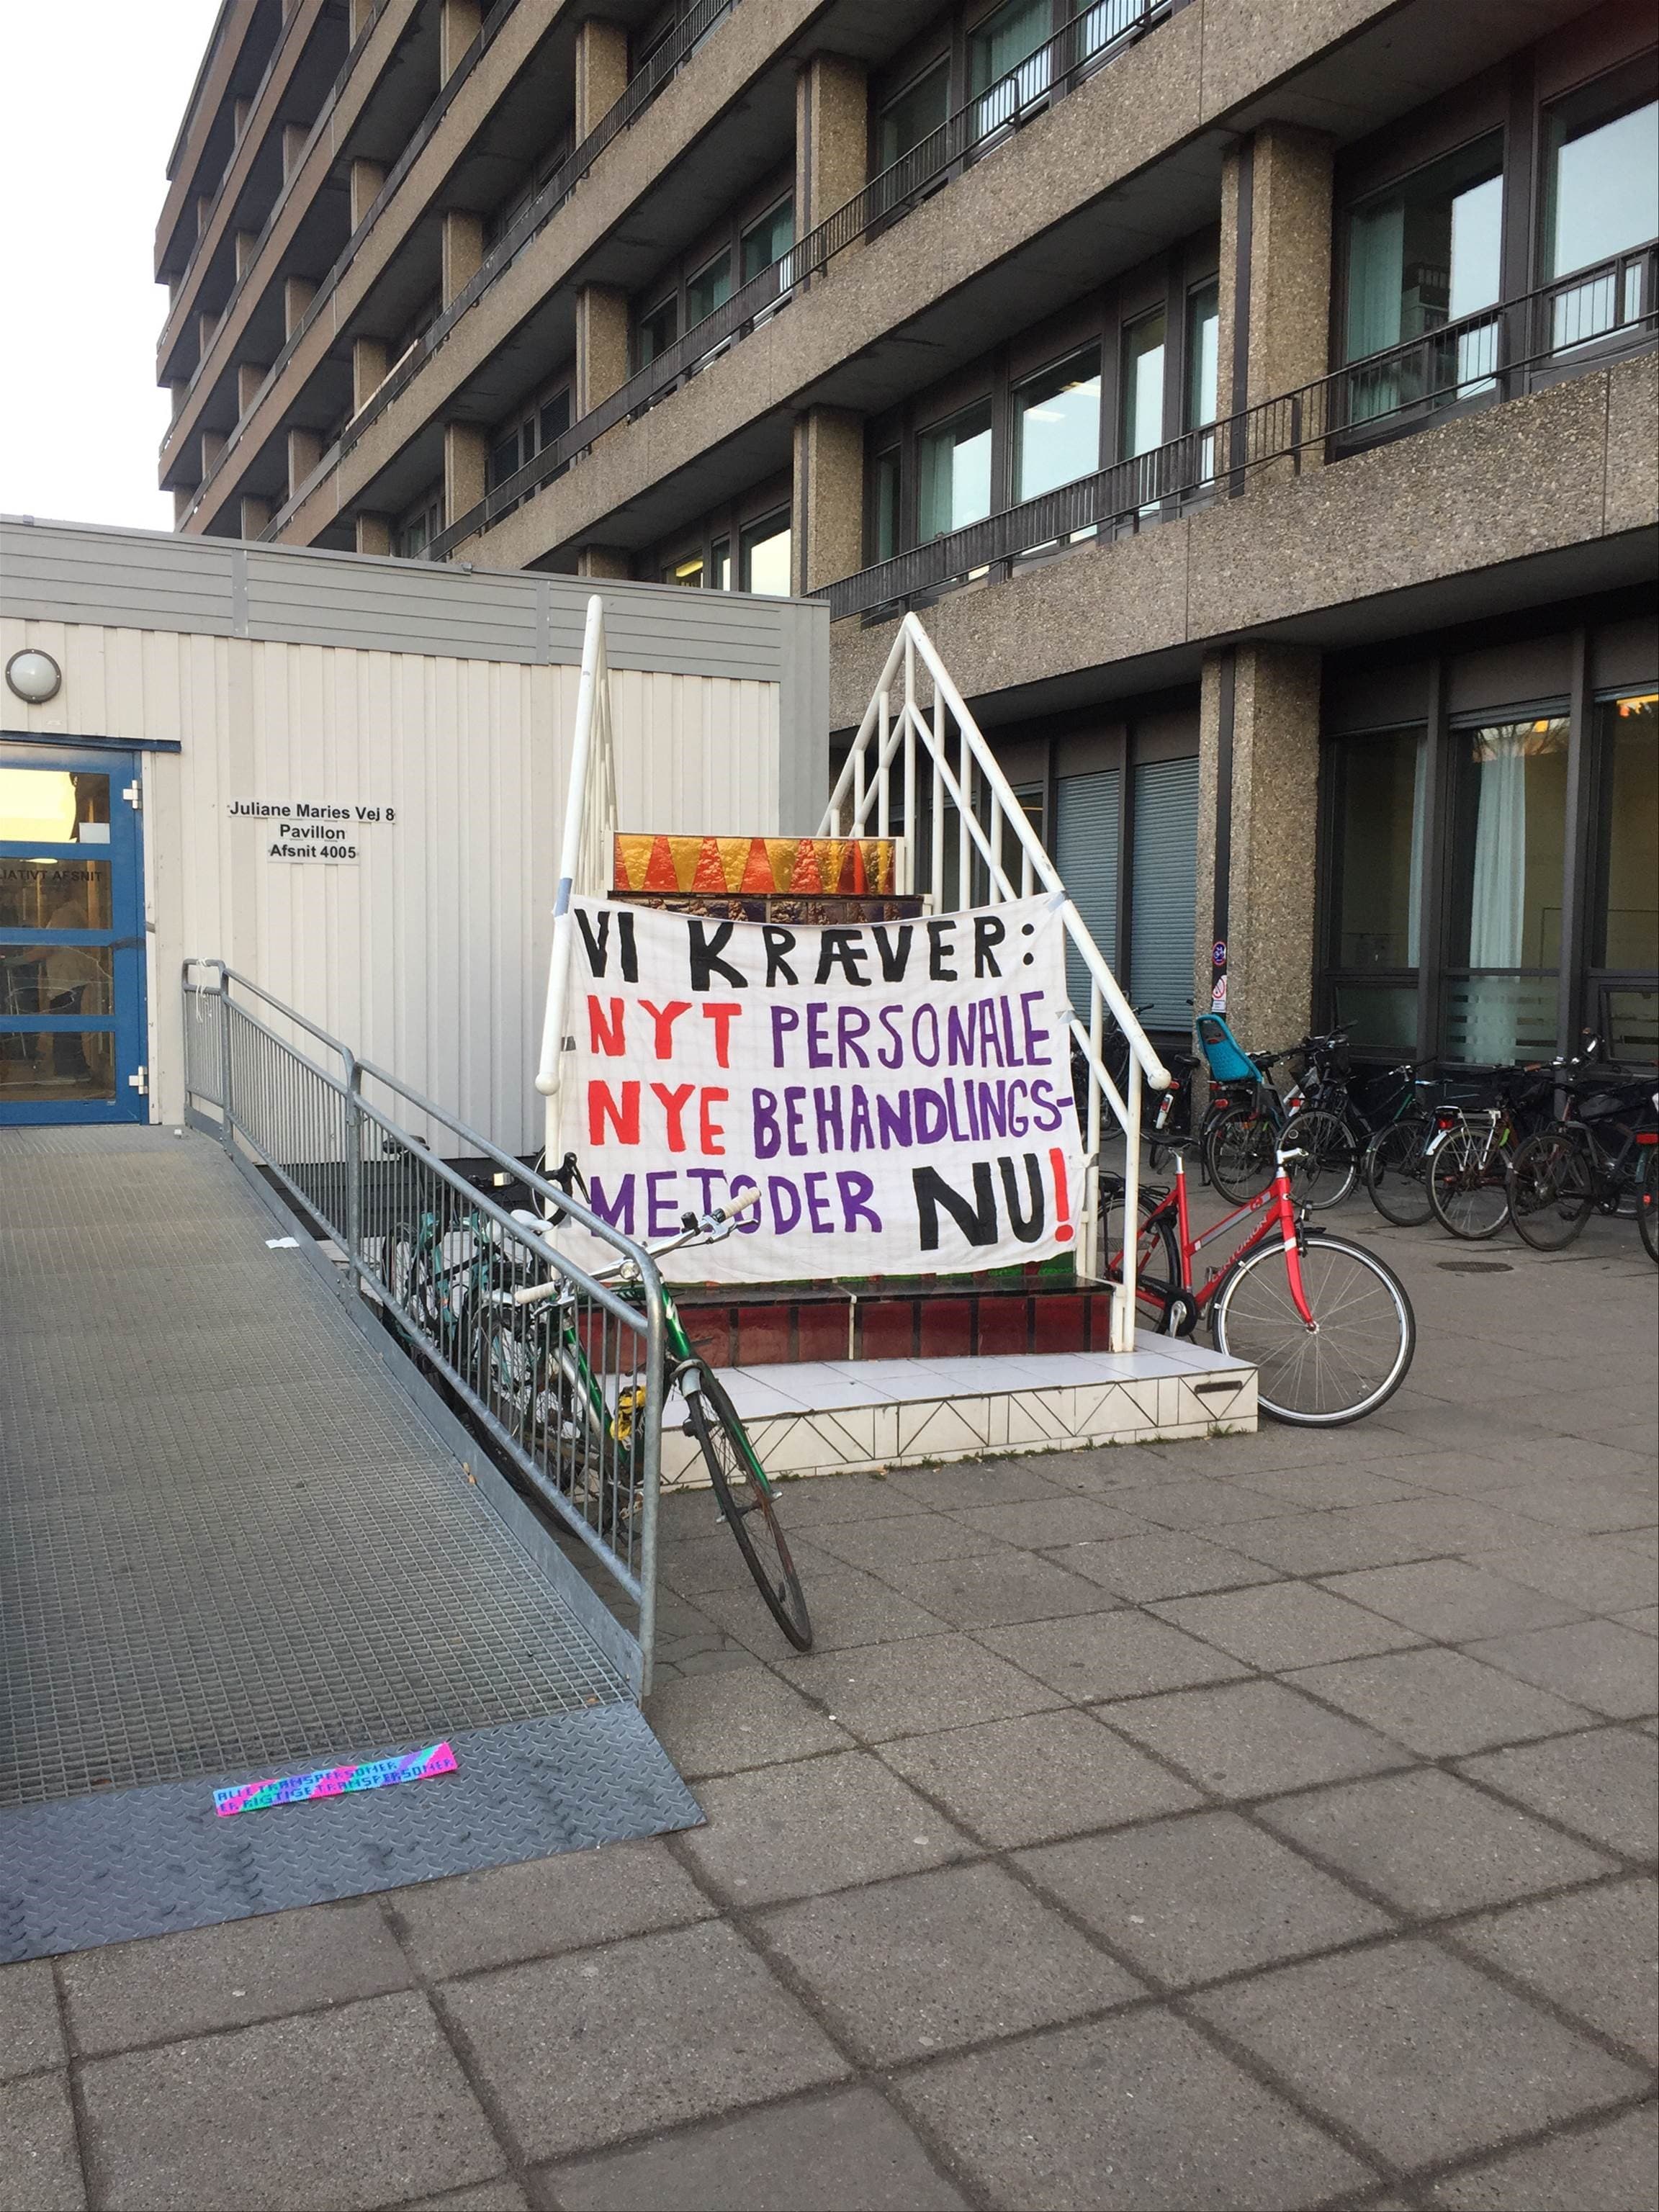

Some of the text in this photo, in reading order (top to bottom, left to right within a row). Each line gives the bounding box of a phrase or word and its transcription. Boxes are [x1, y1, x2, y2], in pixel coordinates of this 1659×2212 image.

[230, 801, 395, 822] Juliane Maries Vej 8
[280, 824, 346, 840] Pavillon
[270, 844, 356, 859] Afsnit 4005
[53, 871, 102, 881] AFSNIT
[575, 909, 1035, 992] VI KRÆVER:
[588, 991, 1053, 1069] NYT PERSONALE
[588, 1076, 1074, 1159] NYE BEHANDLINGS-
[590, 1147, 1074, 1251] METODER NU!
[217, 1787, 253, 1801] ALLE
